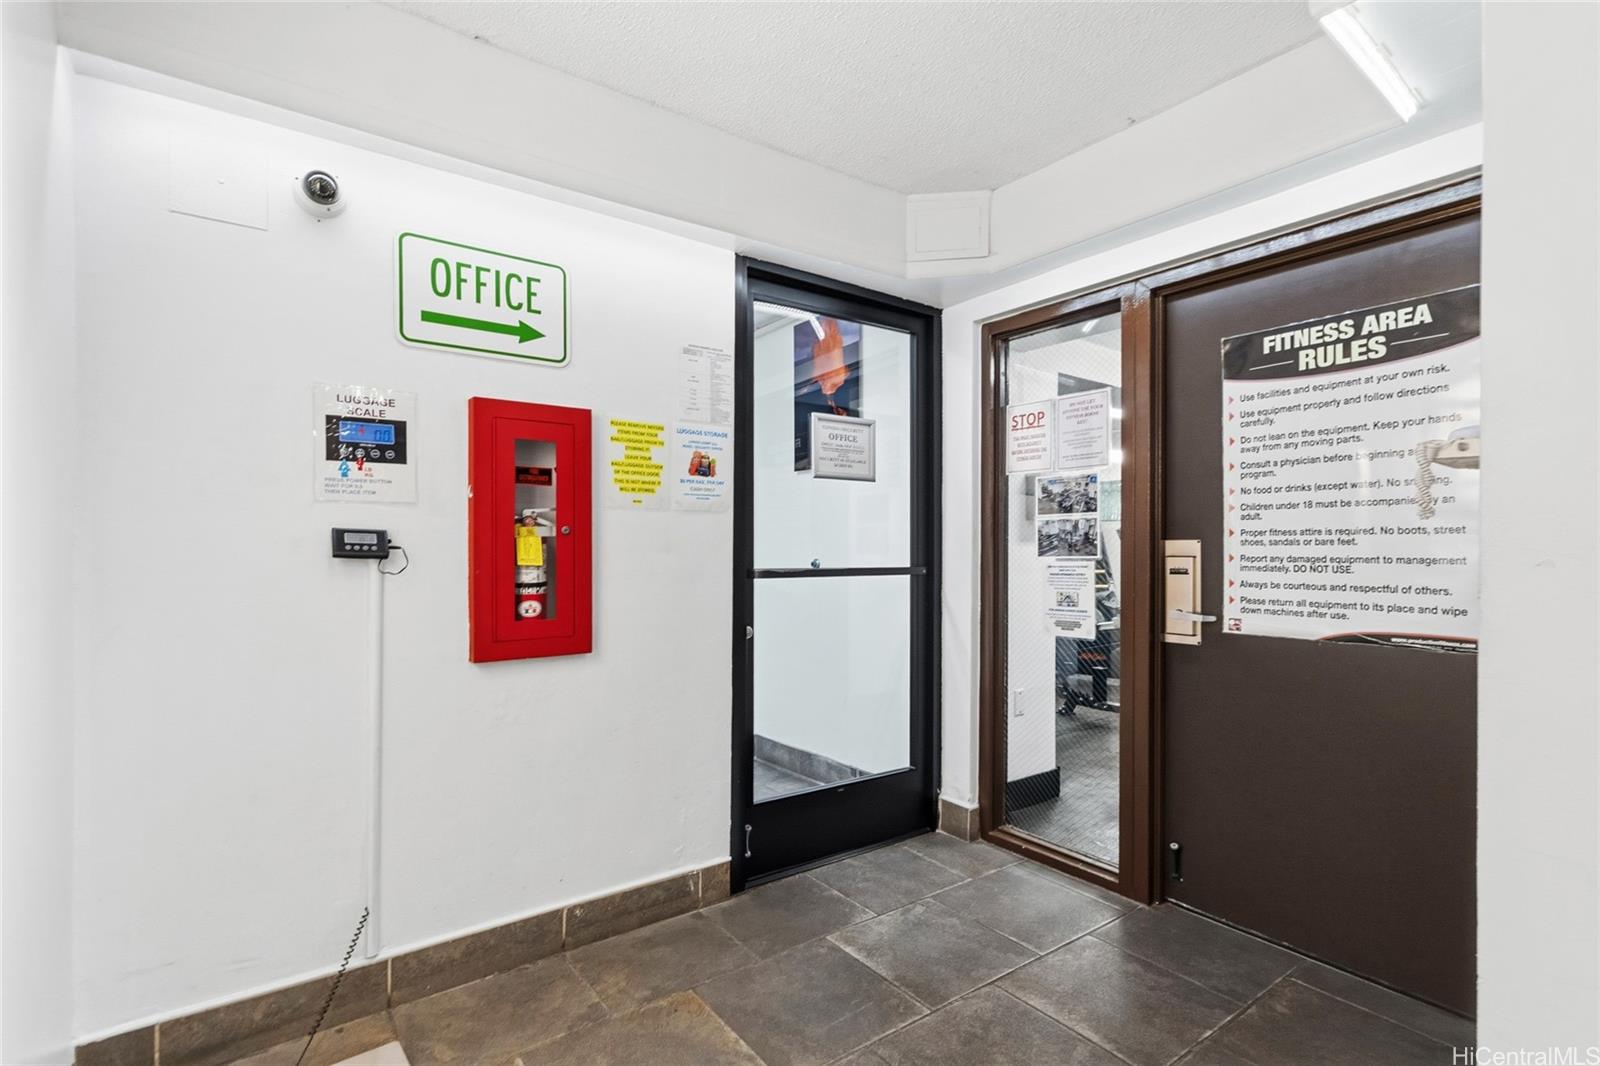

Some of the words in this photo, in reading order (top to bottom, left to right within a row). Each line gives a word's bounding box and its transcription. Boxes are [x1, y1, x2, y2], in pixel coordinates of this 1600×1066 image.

[431, 258, 542, 314] OFFICE
[1262, 319, 1355, 355] FITNESS
[1361, 303, 1433, 336] AREA
[1298, 336, 1387, 371] RULES
[1257, 389, 1291, 399] facilities
[1293, 386, 1309, 394] and
[1312, 376, 1361, 392] equipment
[1364, 376, 1374, 384] at
[1376, 373, 1398, 384] your
[1402, 369, 1424, 378] own
[1427, 364, 1450, 374] risk.
[1257, 404, 1300, 416] equipment
[1304, 400, 1340, 411] properly
[1344, 396, 1360, 404] and
[1364, 392, 1394, 402] follow
[1397, 384, 1450, 398] directions
[347, 407, 386, 418] SCALE
[1012, 411, 1045, 429] STOP
[1240, 417, 1276, 428] carefully.
[1301, 429, 1315, 437] the
[1318, 423, 1370, 435] equipment.
[1373, 420, 1399, 430] Keep
[1402, 418, 1426, 428] your
[1428, 413, 1462, 424] hands
[828, 432, 858, 443] OFFICE
[1240, 446, 1260, 454] away
[1262, 443, 1280, 451] from
[1284, 441, 1298, 450] any
[1301, 437, 1334, 447] moving
[1337, 434, 1364, 444] parts.
[1240, 460, 1270, 470] Consult
[1280, 456, 1320, 468] physician
[1323, 453, 1352, 462] before
[1356, 448, 1405, 461] bginning
[1240, 470, 1276, 480] program.
[1285, 484, 1312, 492] drinks
[1314, 482, 1348, 492] (except
[1386, 478, 1400, 486] No
[1240, 503, 1274, 511] Children
[1276, 502, 1300, 510] under
[1303, 500, 1312, 508] 18
[1315, 500, 1338, 508] must
[1340, 499, 1352, 507] be
[1354, 496, 1419, 507] accompanie
[1240, 528, 1267, 538] Proper
[1269, 528, 1298, 536] fitness
[1335, 526, 1377, 537] required.
[1380, 526, 1394, 534] No
[1398, 526, 1430, 536] boots,
[1434, 526, 1466, 534] street
[1240, 538, 1266, 546] shoes,
[1268, 538, 1300, 546] sandals
[1337, 538, 1358, 546] feet.
[1240, 554, 1268, 564] Report
[1270, 556, 1284, 564] any
[1286, 556, 1326, 565] damaged
[1330, 556, 1380, 565] equipment
[1396, 556, 1467, 566] management
[1240, 564, 1291, 574] immediately.
[1293, 564, 1307, 572] DO
[1310, 564, 1329, 573] NOT
[1332, 565, 1354, 574] USE.
[1240, 580, 1268, 590] Always
[1270, 581, 1280, 589] be
[1283, 582, 1326, 591] courteous
[1330, 584, 1346, 592] and
[1350, 584, 1398, 594] respectful
[1401, 585, 1412, 594] of
[1414, 586, 1453, 596] others.
[1240, 596, 1266, 605] Please
[1268, 598, 1294, 606] return
[1296, 599, 1306, 608] all
[1309, 600, 1358, 610] equipment
[1360, 602, 1370, 611] to
[1372, 603, 1384, 612] its
[1387, 604, 1414, 614] place
[1418, 606, 1438, 614] and
[1441, 607, 1468, 618] wipe
[1240, 606, 1261, 614] down
[1264, 608, 1304, 617] machines
[1306, 610, 1328, 618] after
[1330, 611, 1350, 620] use.
